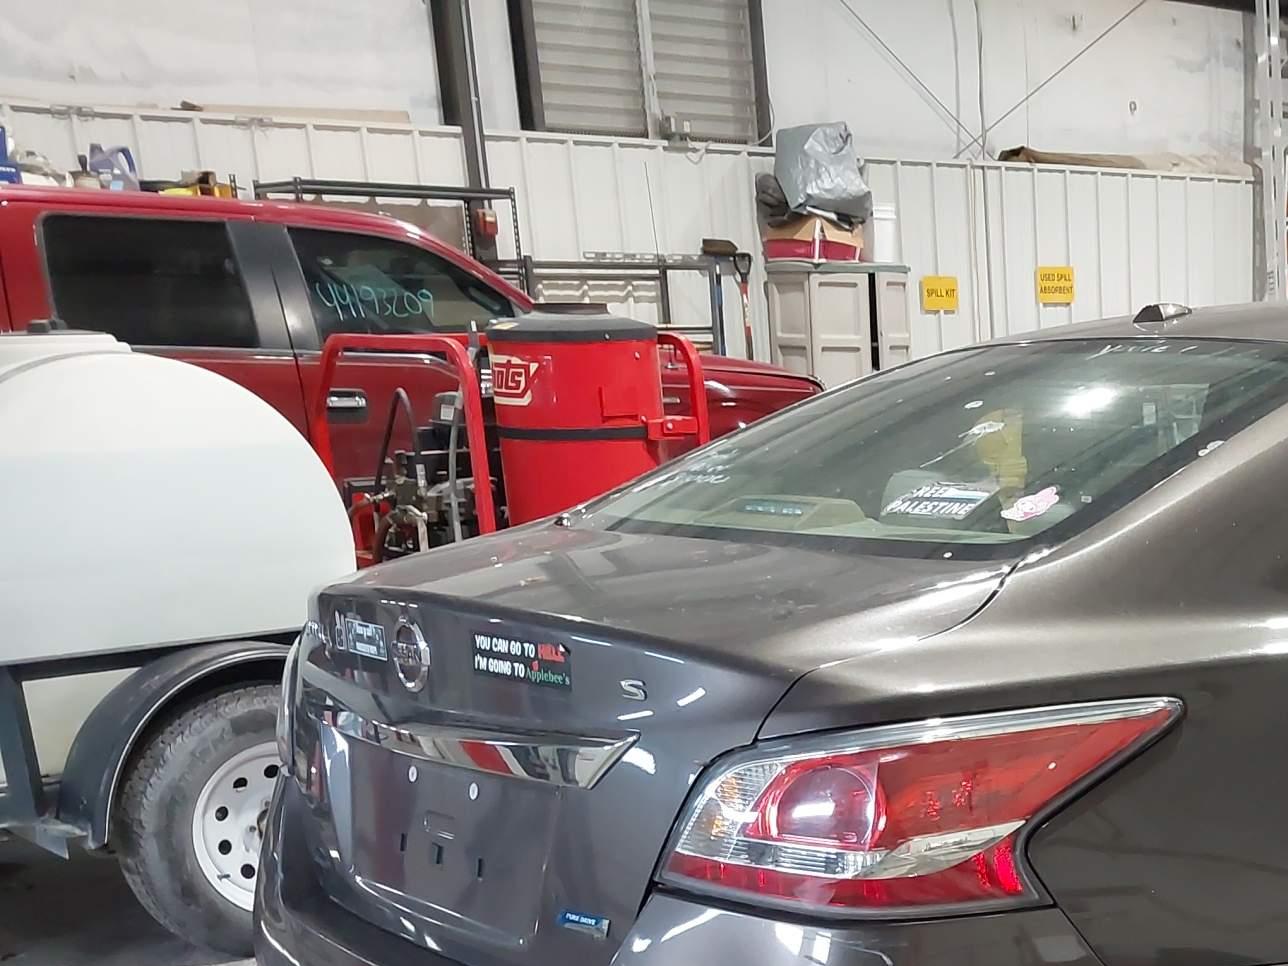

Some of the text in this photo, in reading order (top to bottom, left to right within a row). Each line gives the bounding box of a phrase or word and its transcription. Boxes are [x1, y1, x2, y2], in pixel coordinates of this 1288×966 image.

[1040, 273, 1071, 281] USED SPILL
[926, 287, 956, 298] SPILL KIT
[1040, 286, 1073, 294] ABSORBENT
[886, 501, 976, 514] PALESTINE
[474, 634, 490, 651] YOU
[491, 637, 508, 655] CAN
[509, 640, 522, 656] GO
[522, 642, 536, 658] TO
[474, 654, 570, 686] I'M GOING TO Applebee's
[620, 679, 647, 701] S
